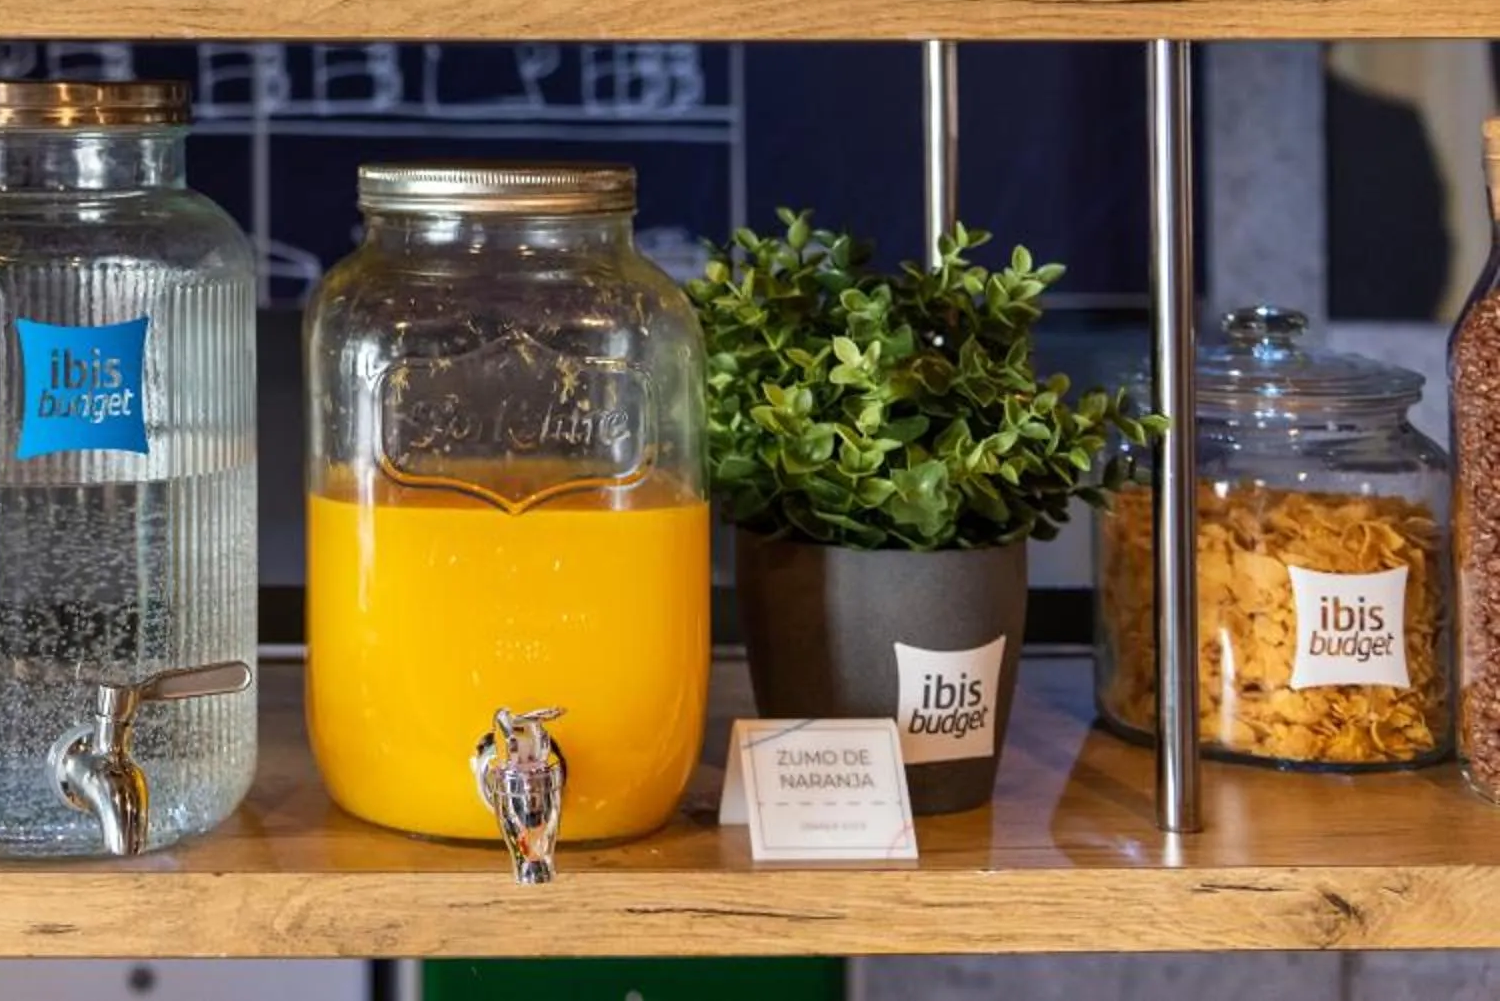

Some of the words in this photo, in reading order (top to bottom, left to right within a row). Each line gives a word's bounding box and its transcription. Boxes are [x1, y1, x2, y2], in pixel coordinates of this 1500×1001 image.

[51, 348, 123, 390] ibis
[38, 388, 135, 424] budget
[1319, 596, 1386, 632] ibis
[1309, 627, 1395, 663] budget
[922, 674, 983, 710] ibis
[908, 704, 990, 740] budget
[776, 749, 838, 766] ZUMO
[843, 749, 872, 766] DE
[779, 772, 876, 789] NARANJA
